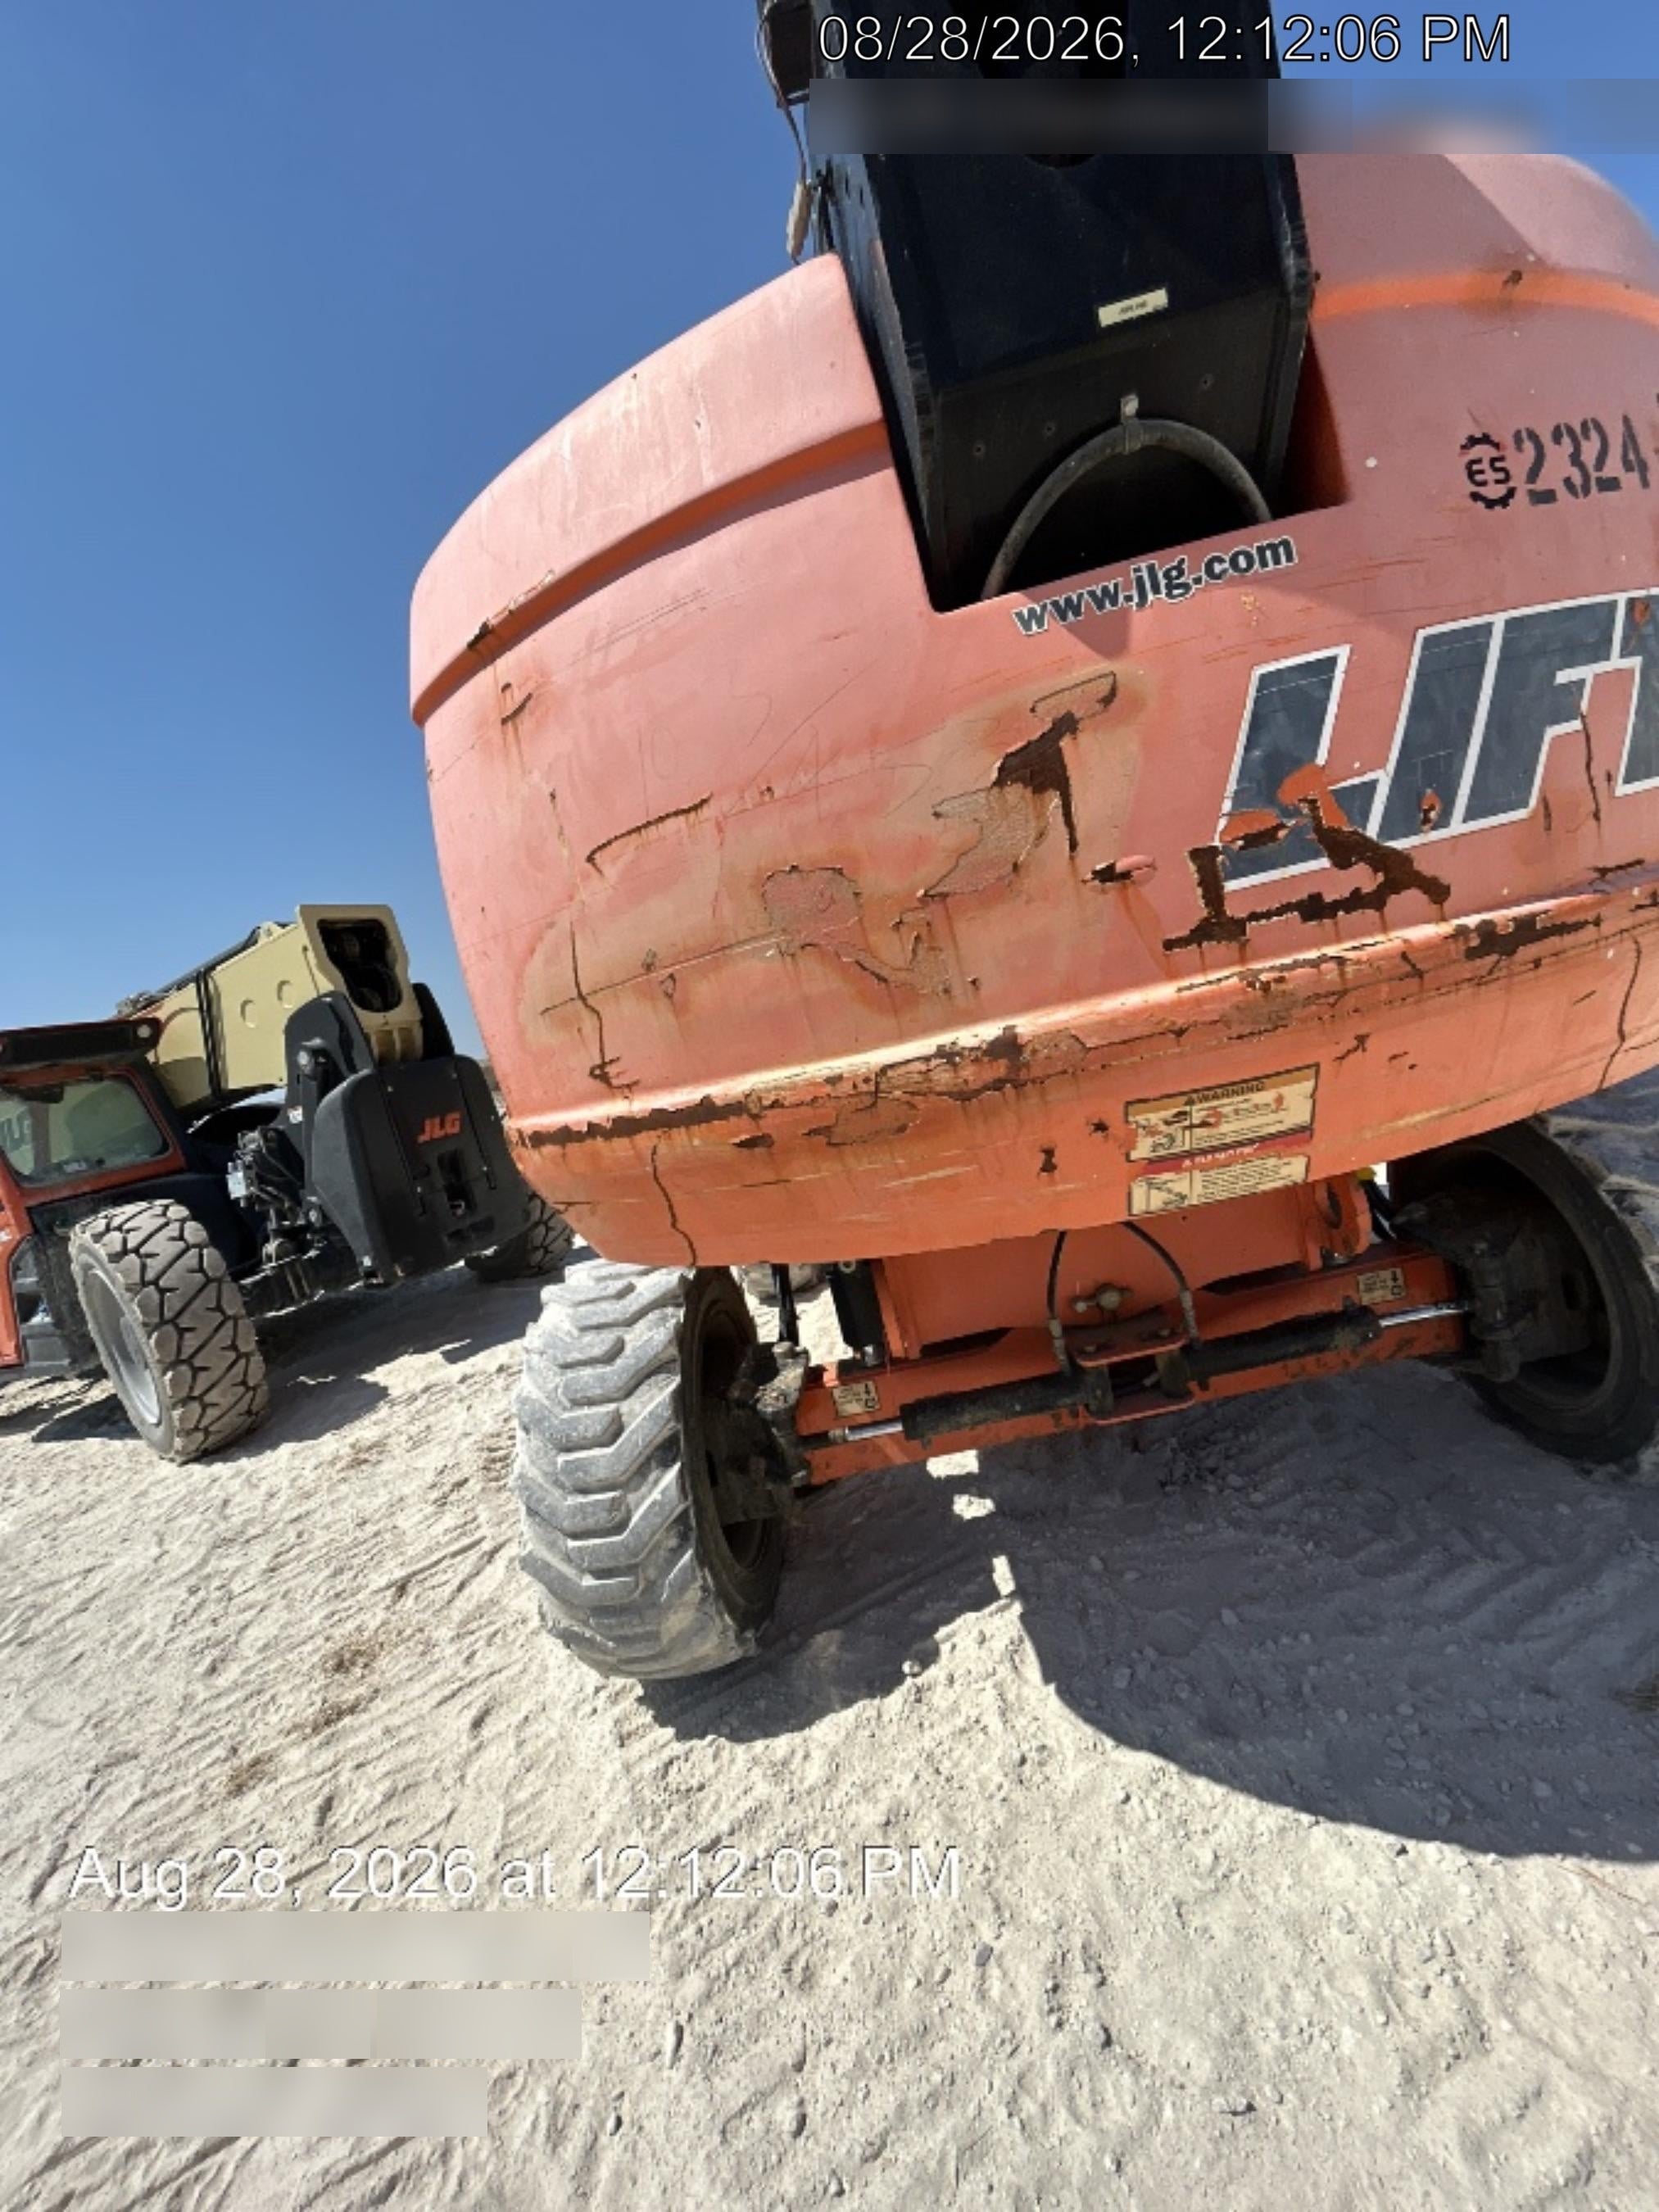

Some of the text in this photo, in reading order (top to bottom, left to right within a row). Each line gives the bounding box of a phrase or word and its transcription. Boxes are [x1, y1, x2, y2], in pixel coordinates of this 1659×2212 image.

[1513, 392, 1659, 506] 2324
[1012, 535, 1298, 635] www.jlg.com
[1214, 585, 1659, 891] LIF
[418, 1112, 460, 1143] JLG
[1197, 1080, 1265, 1104] WARNING
